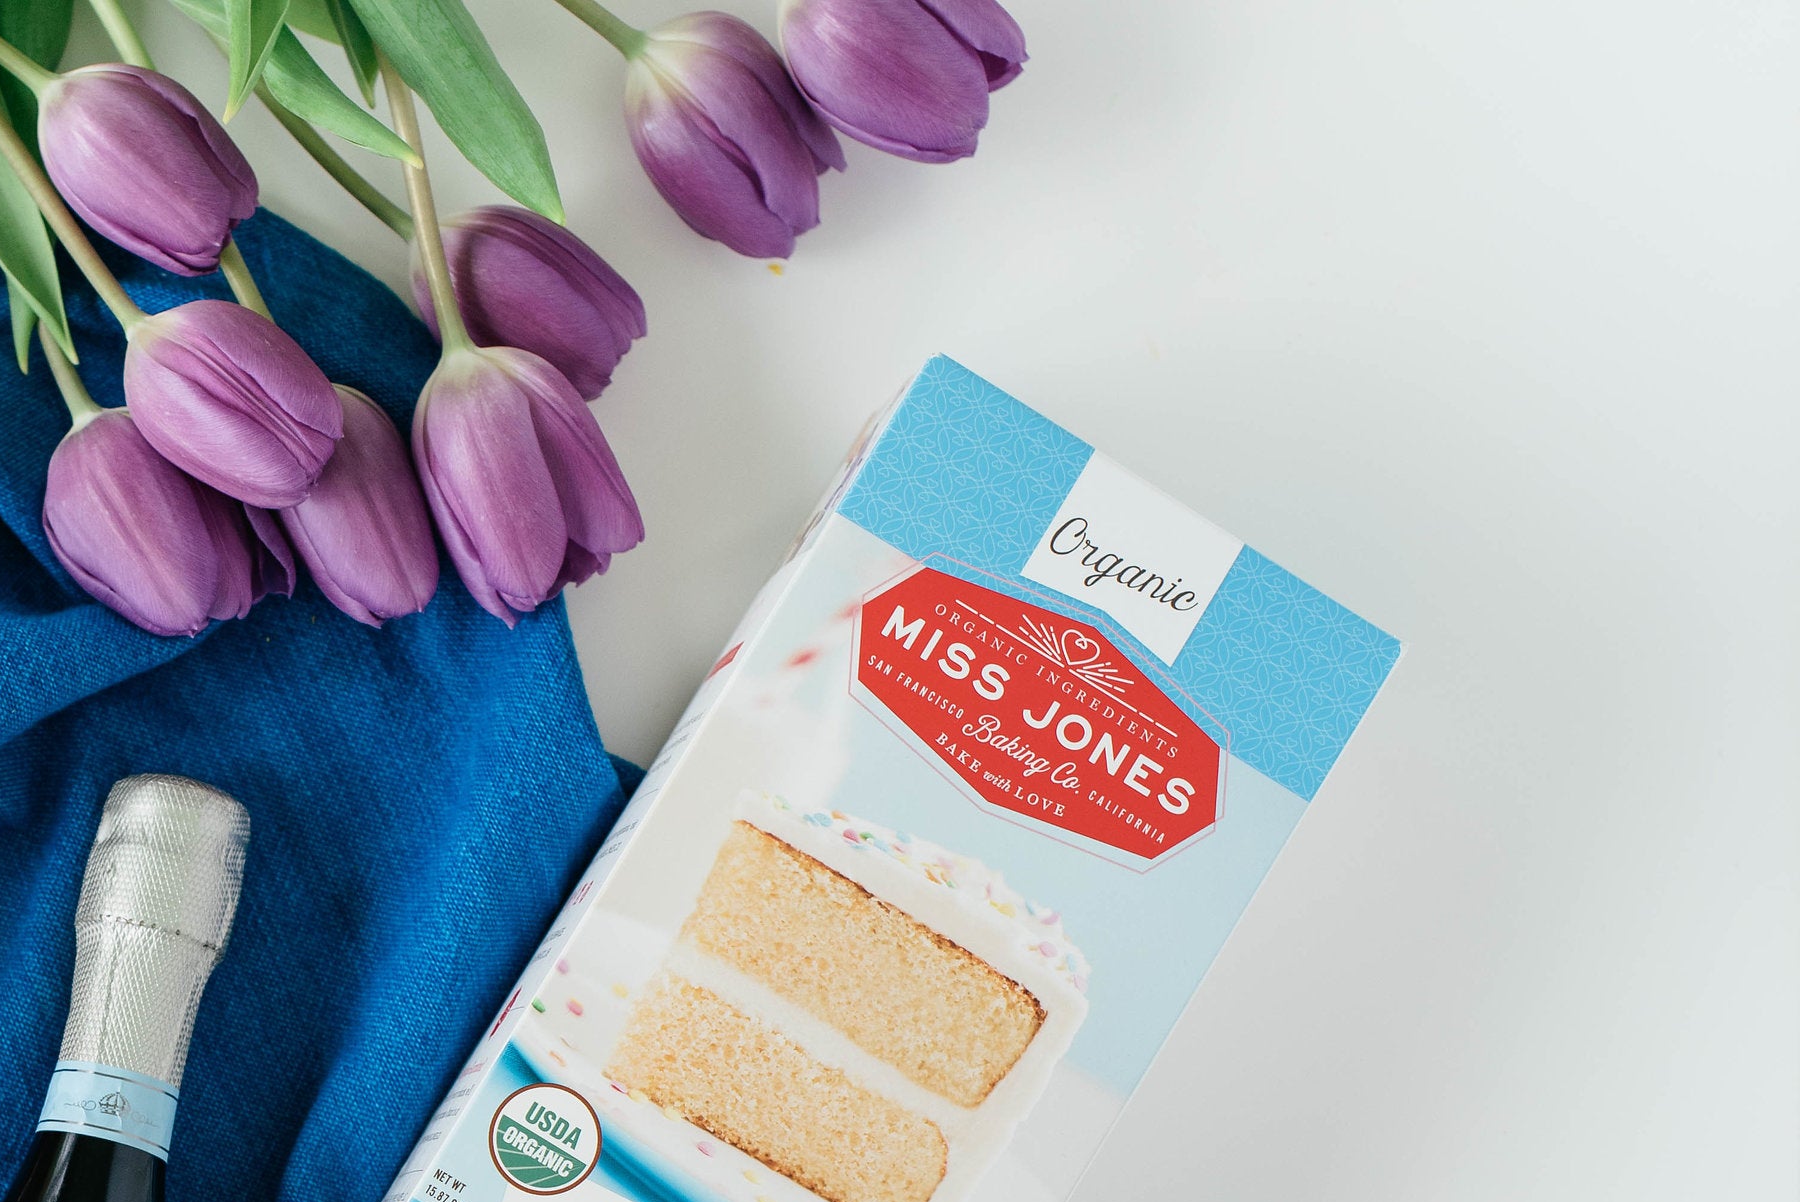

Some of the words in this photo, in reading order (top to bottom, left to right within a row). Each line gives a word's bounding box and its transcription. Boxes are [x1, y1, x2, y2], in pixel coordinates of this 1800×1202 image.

[1050, 517, 1198, 611] Organic
[881, 605, 1011, 701] MISS
[1023, 700, 1196, 815] JONES
[934, 603, 1028, 665] ORGANIC
[1036, 665, 1178, 758] INGREDIENTS
[867, 655, 893, 676] SAN
[896, 672, 965, 719] FRANCISCO
[962, 714, 1050, 777] Baking
[1050, 762, 1081, 794] Co.
[1088, 790, 1166, 844] CALIFORNIA
[935, 732, 982, 773] BAKE
[983, 770, 1011, 793] with
[1013, 786, 1066, 817] LOVE
[502, 1126, 574, 1178] ORGANIC
[525, 1101, 582, 1150] USDA
[433, 1169, 451, 1184] NET
[452, 1178, 467, 1193] WT
